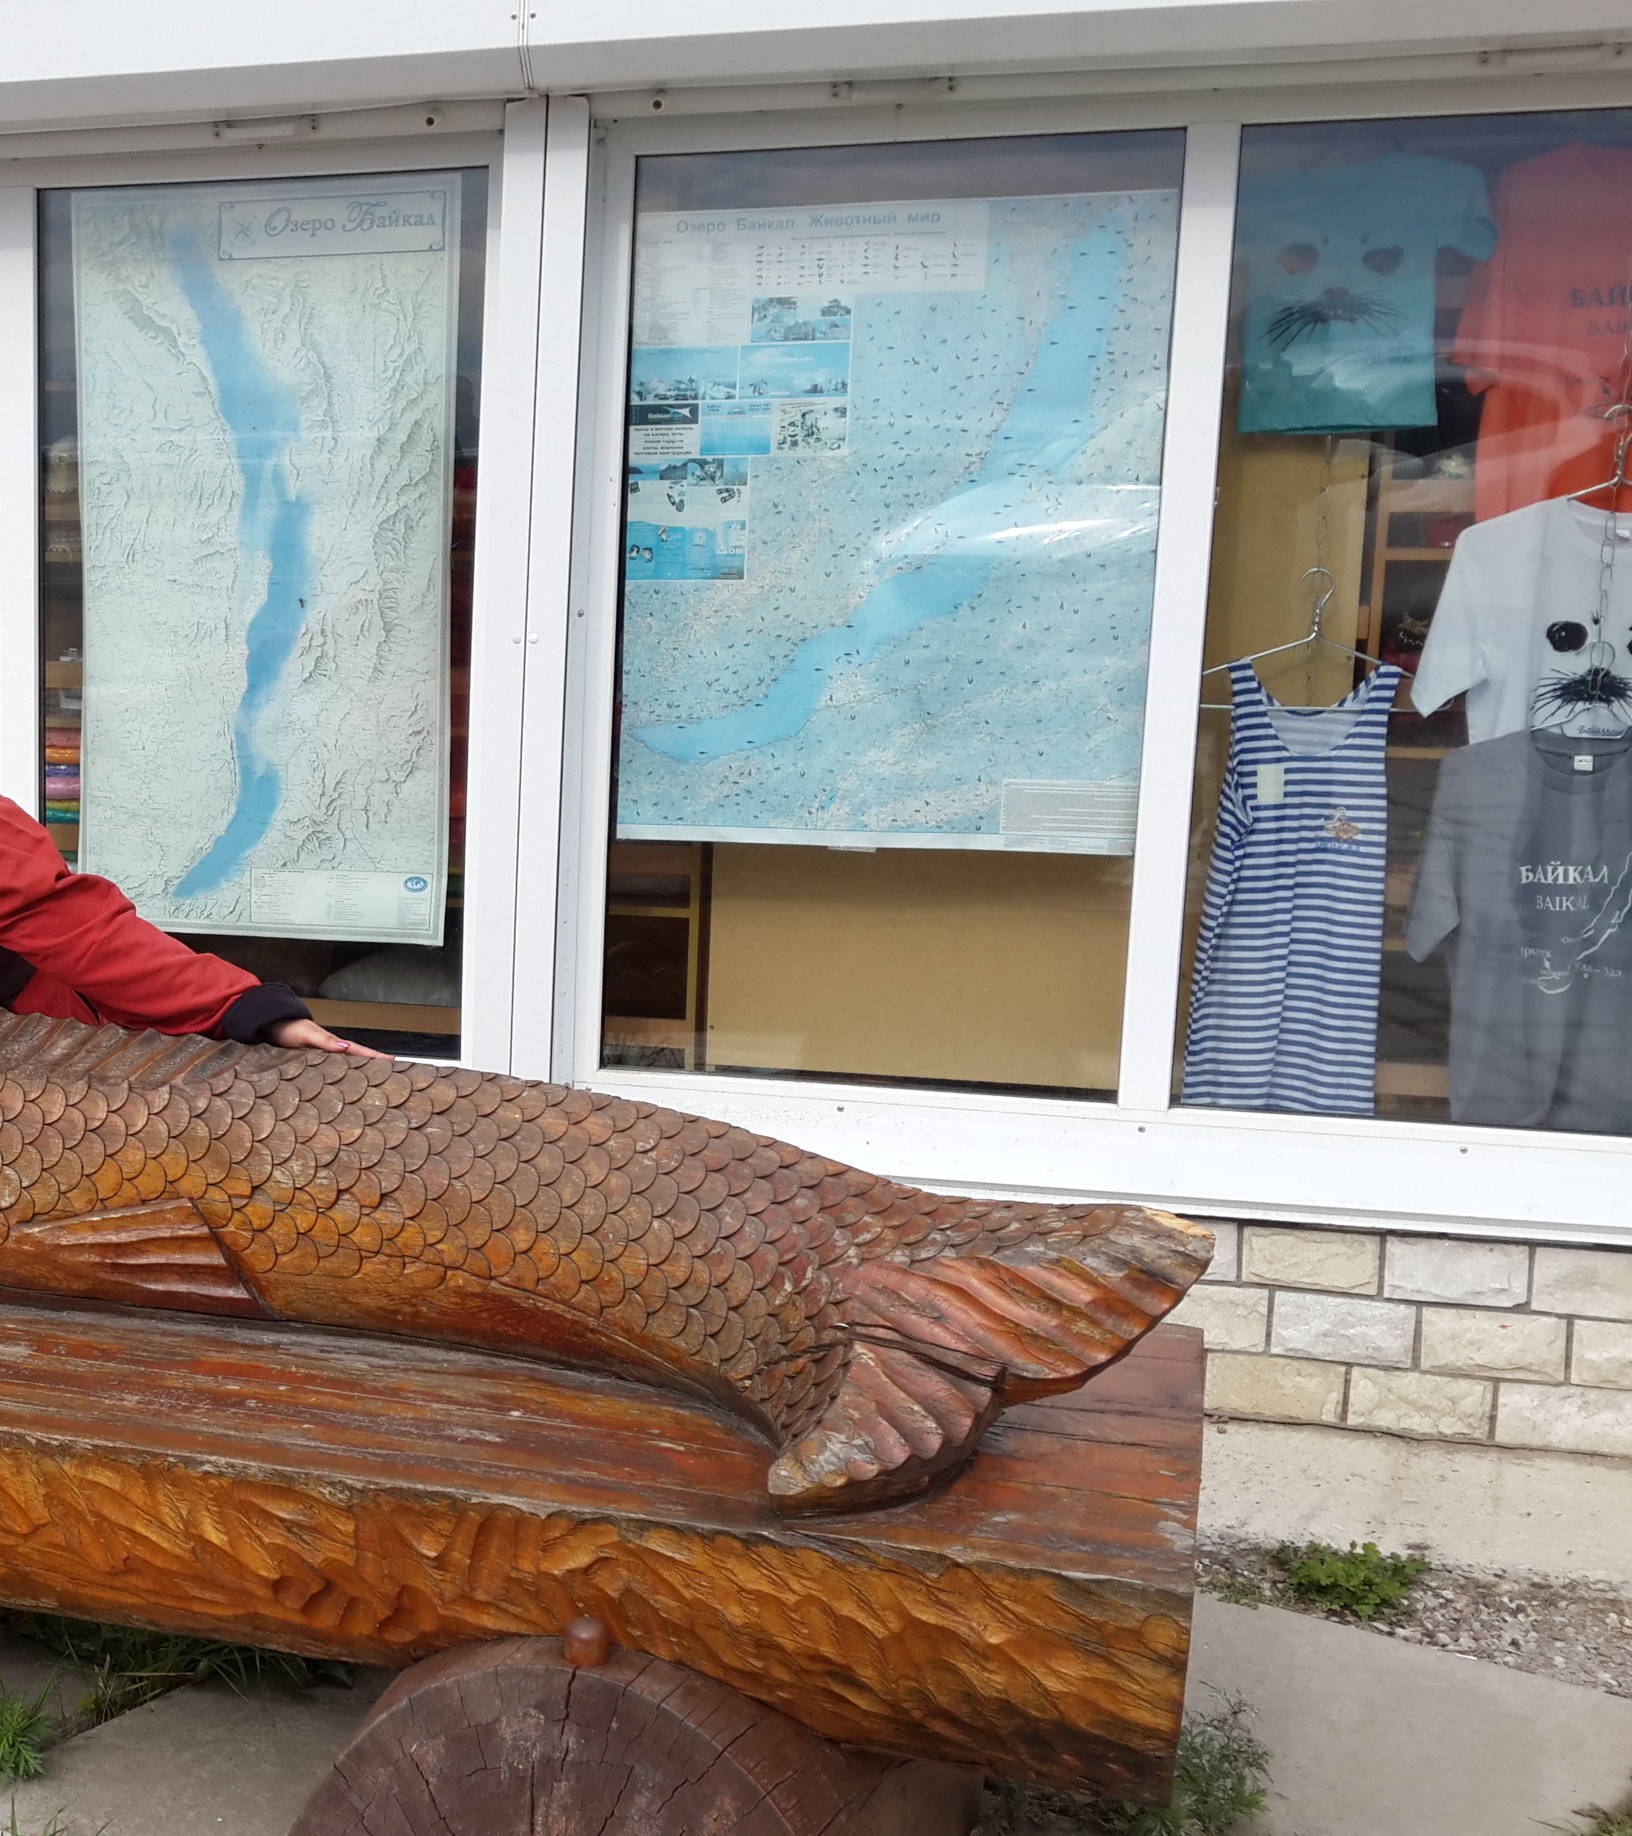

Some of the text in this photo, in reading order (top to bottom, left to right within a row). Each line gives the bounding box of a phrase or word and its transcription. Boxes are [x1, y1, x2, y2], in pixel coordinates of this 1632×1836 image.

[264, 201, 437, 237] Озеро Байкал
[676, 211, 941, 235] Озеро Байкал. Животный мир
[1570, 283, 1632, 309] БАЙ
[1519, 861, 1609, 885] БАЙКАЛ
[1536, 894, 1590, 911] BAIKAL
